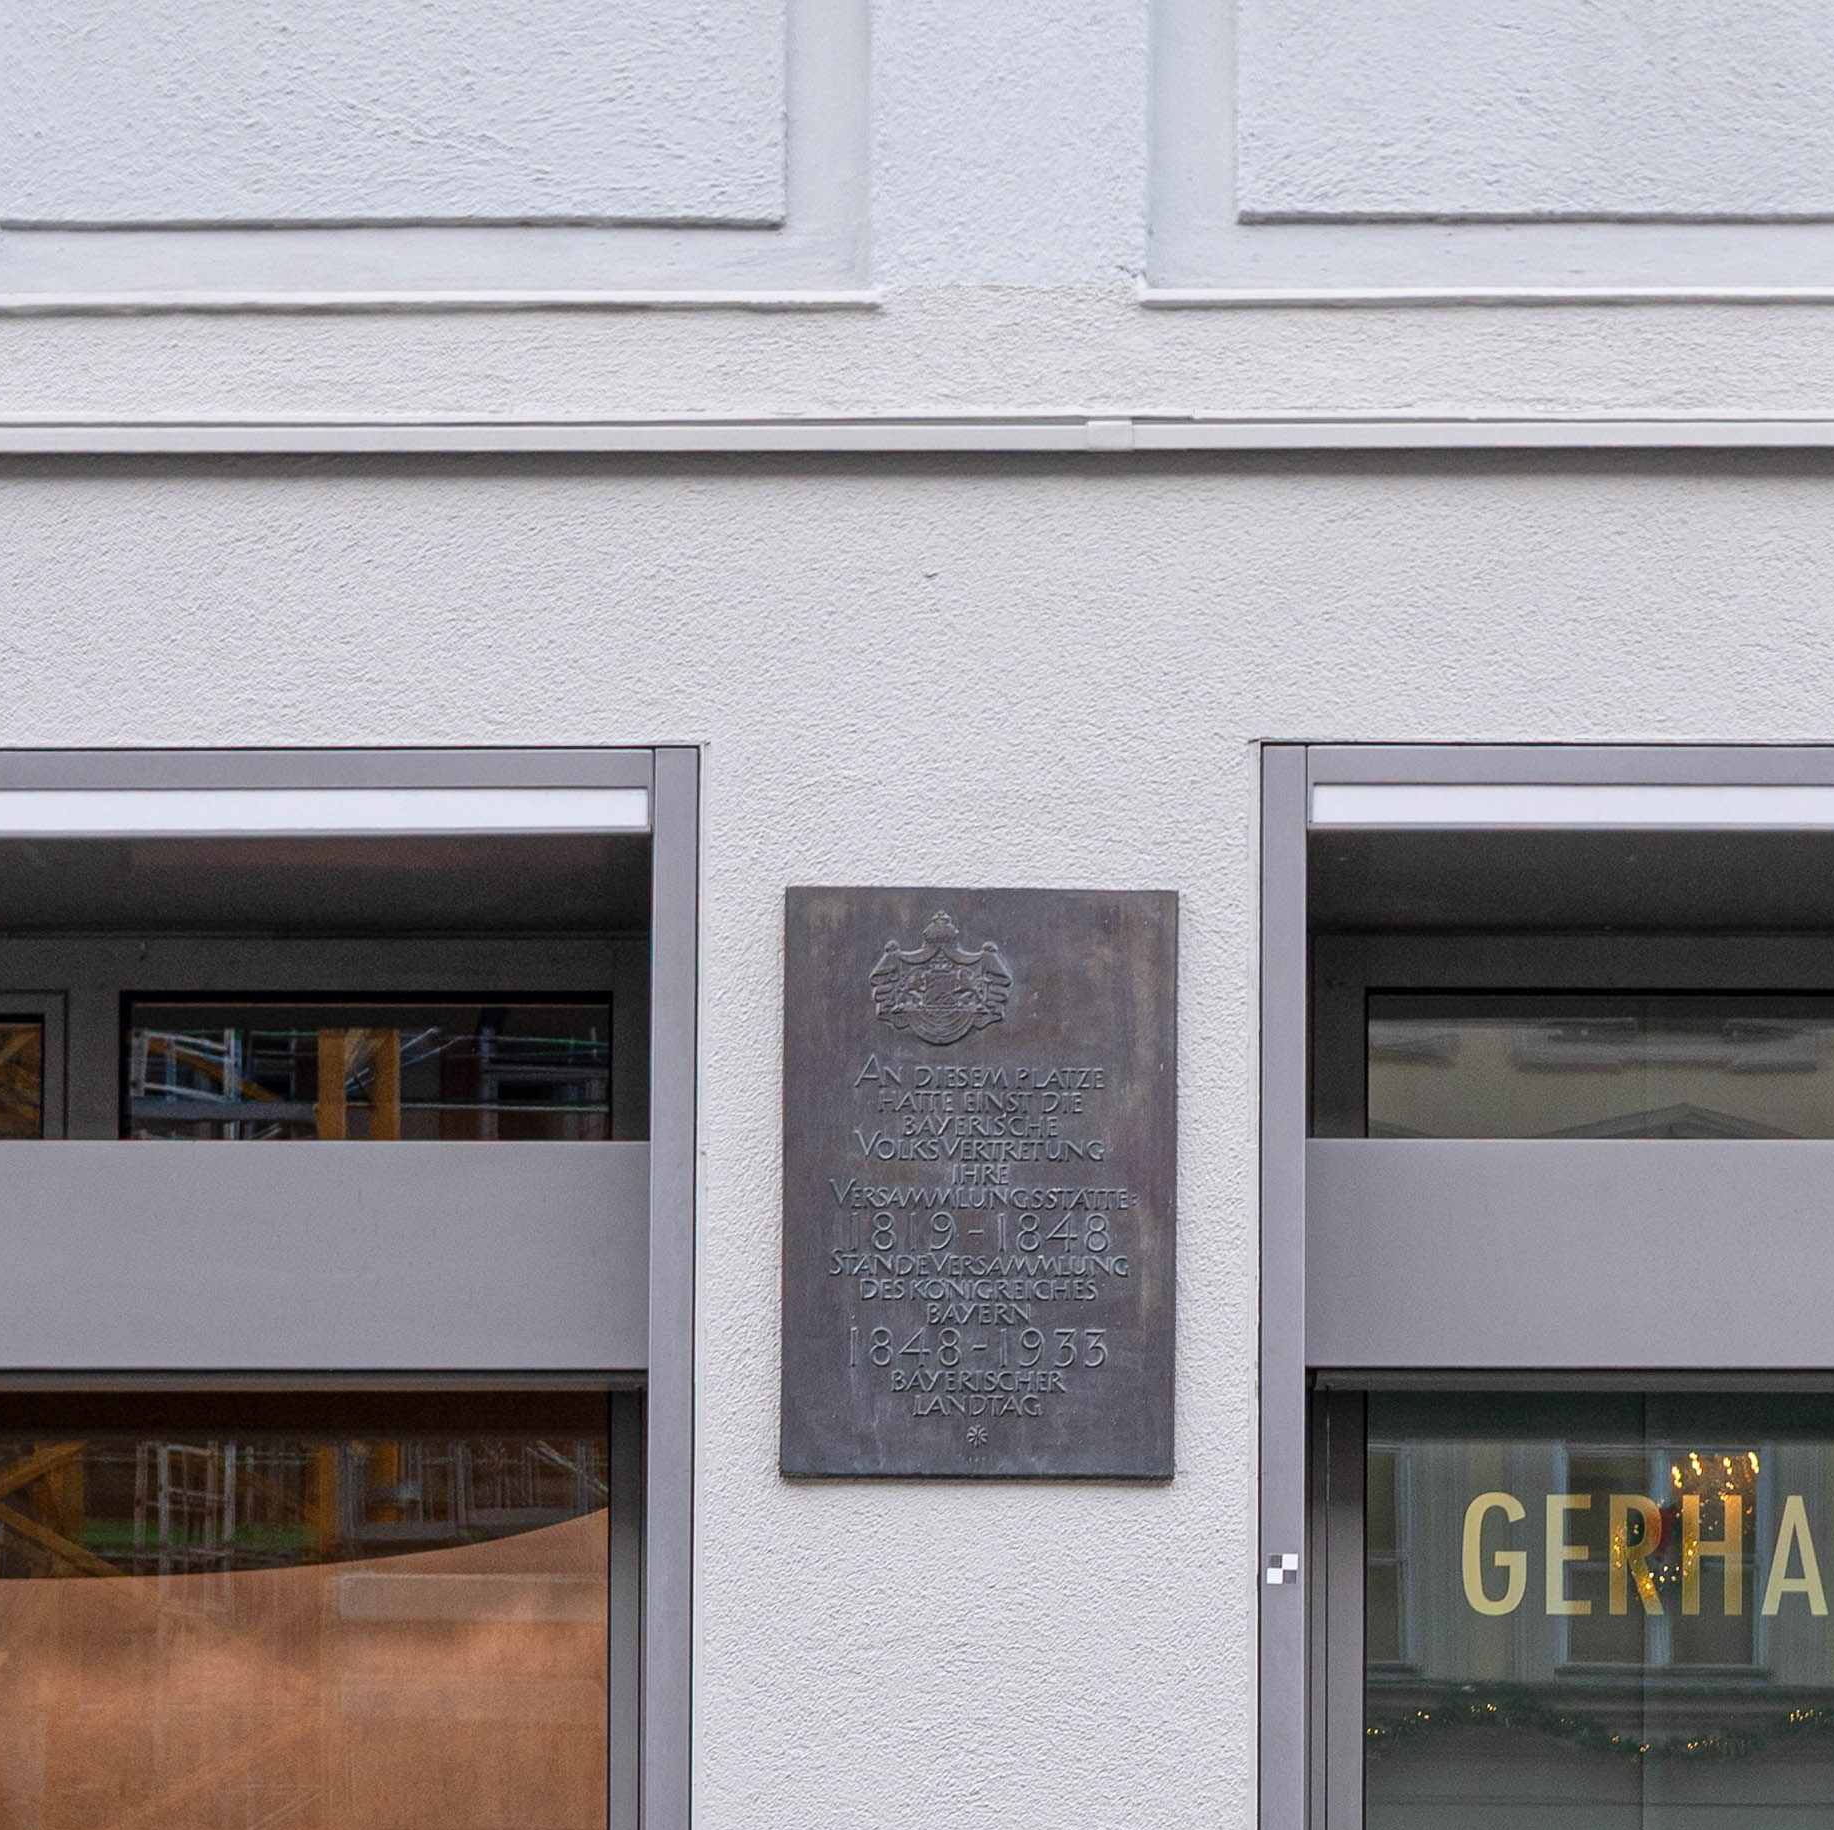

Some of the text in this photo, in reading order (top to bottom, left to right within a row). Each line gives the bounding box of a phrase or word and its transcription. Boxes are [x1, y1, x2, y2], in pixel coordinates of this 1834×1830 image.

[854, 1053, 1106, 1090] AN DIESEM PLATZE
[878, 1090, 1083, 1113] HATTE EINST DIE
[902, 1115, 1059, 1137] BAYERISCHE
[854, 1130, 1106, 1162] VOLKSVERTRETUNG
[951, 1164, 1009, 1186] IHRE
[859, 1278, 905, 1301] DES
[926, 1302, 1033, 1325] BAYERN
[849, 1326, 1110, 1368] 1848-1933
[890, 1369, 1068, 1392] BAYERISCHER
[912, 1394, 1044, 1417] LANDTAG
